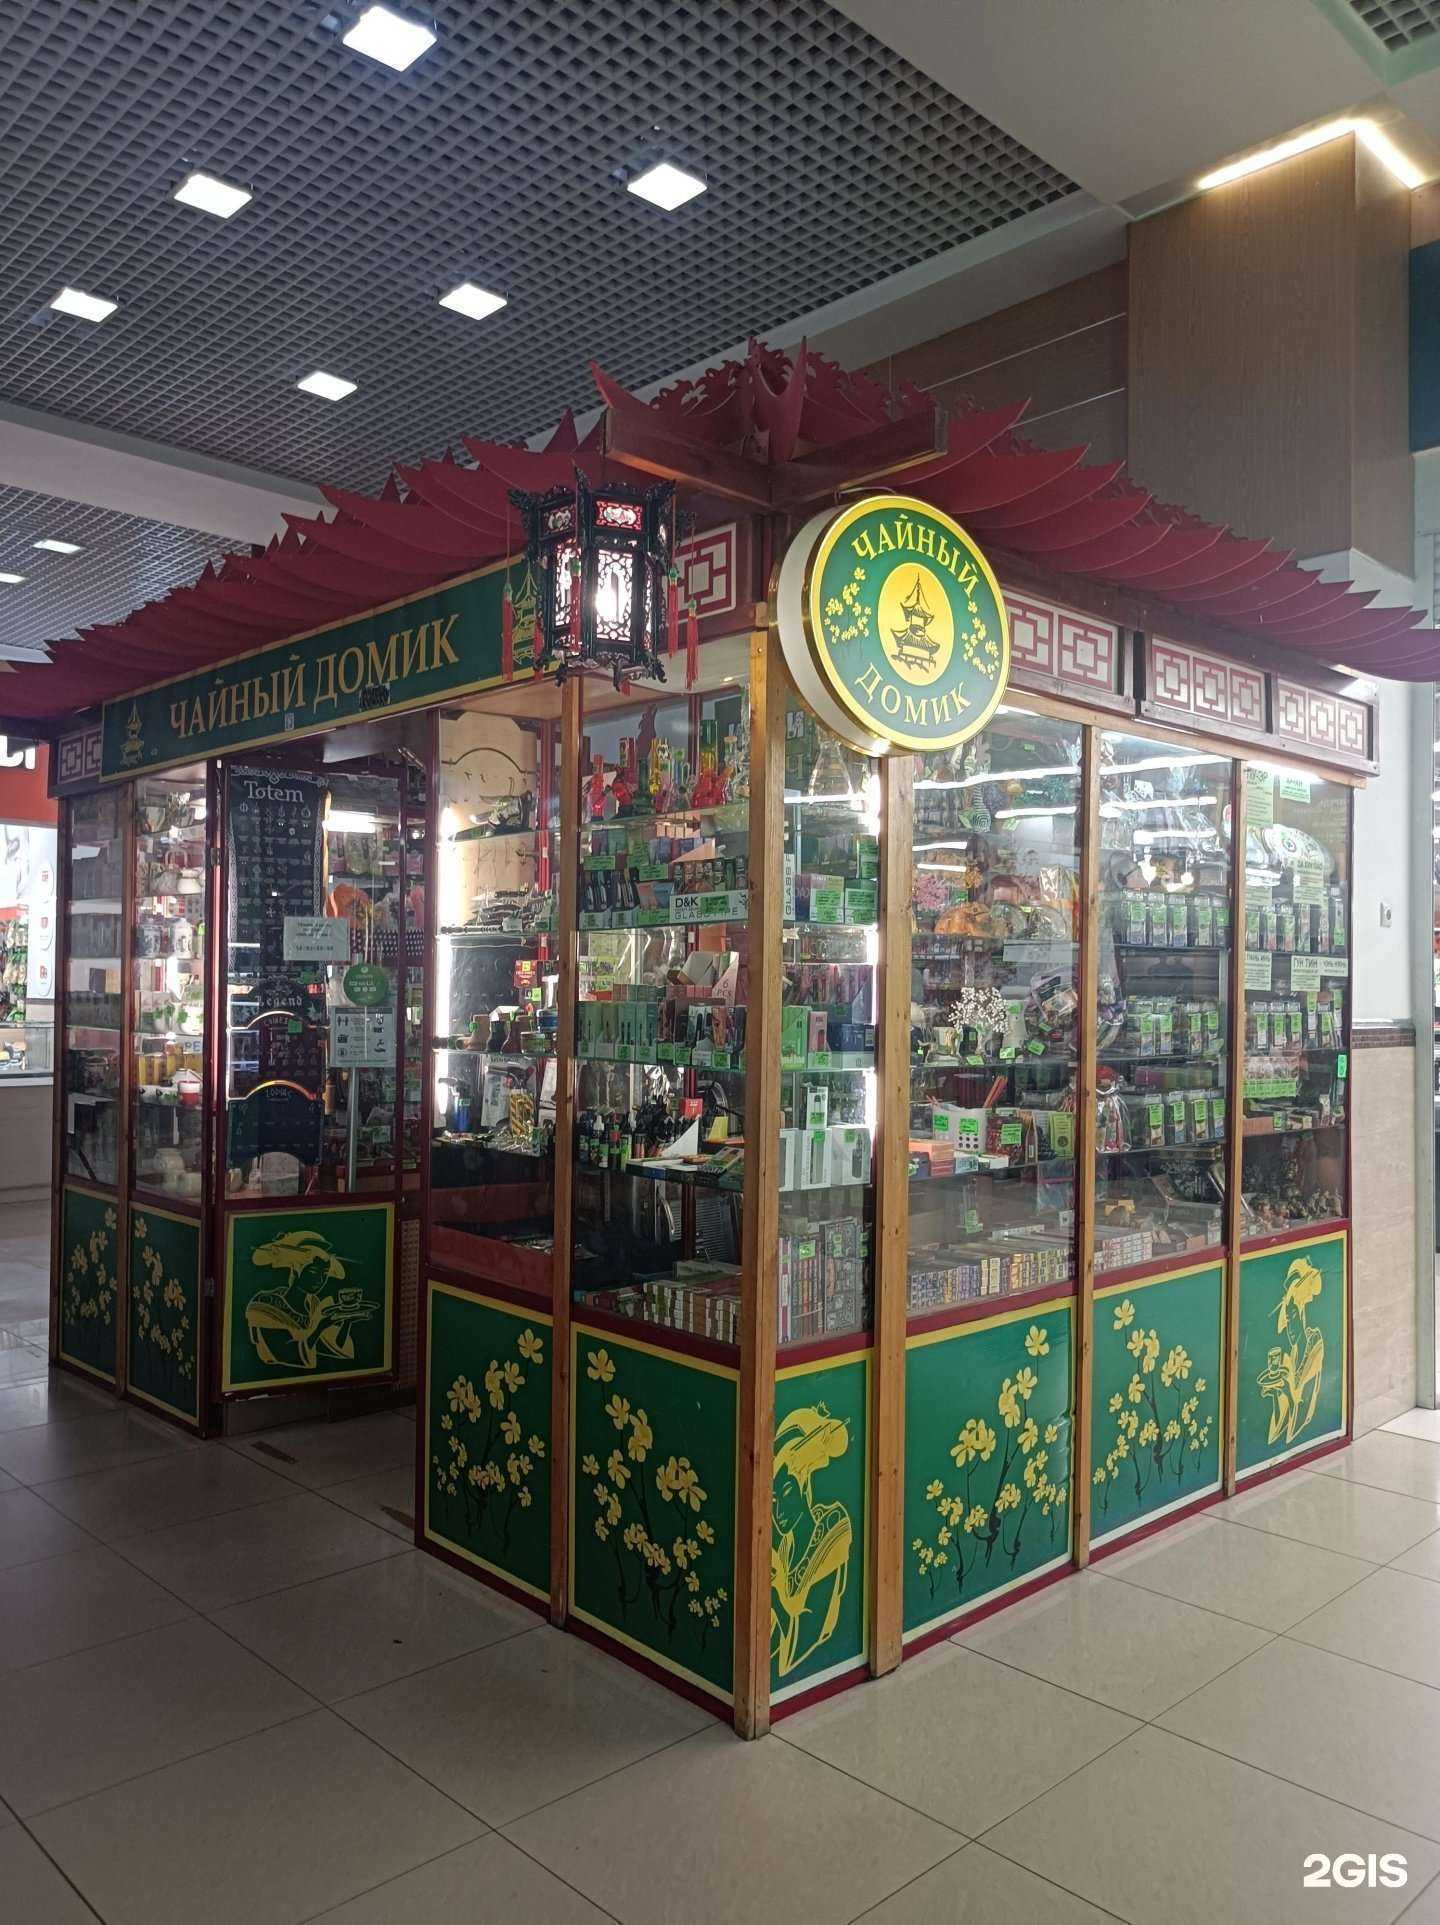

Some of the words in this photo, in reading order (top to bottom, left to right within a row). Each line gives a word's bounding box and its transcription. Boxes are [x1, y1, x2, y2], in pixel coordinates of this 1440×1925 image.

[851, 514, 981, 598] ЧАЙНЫЙ
[169, 654, 306, 739] ЧАЙНЫЙ
[313, 613, 460, 712] ДОМИК
[854, 662, 972, 727] ДОМИК
[243, 780, 304, 803] Totem
[675, 896, 699, 908] D&K
